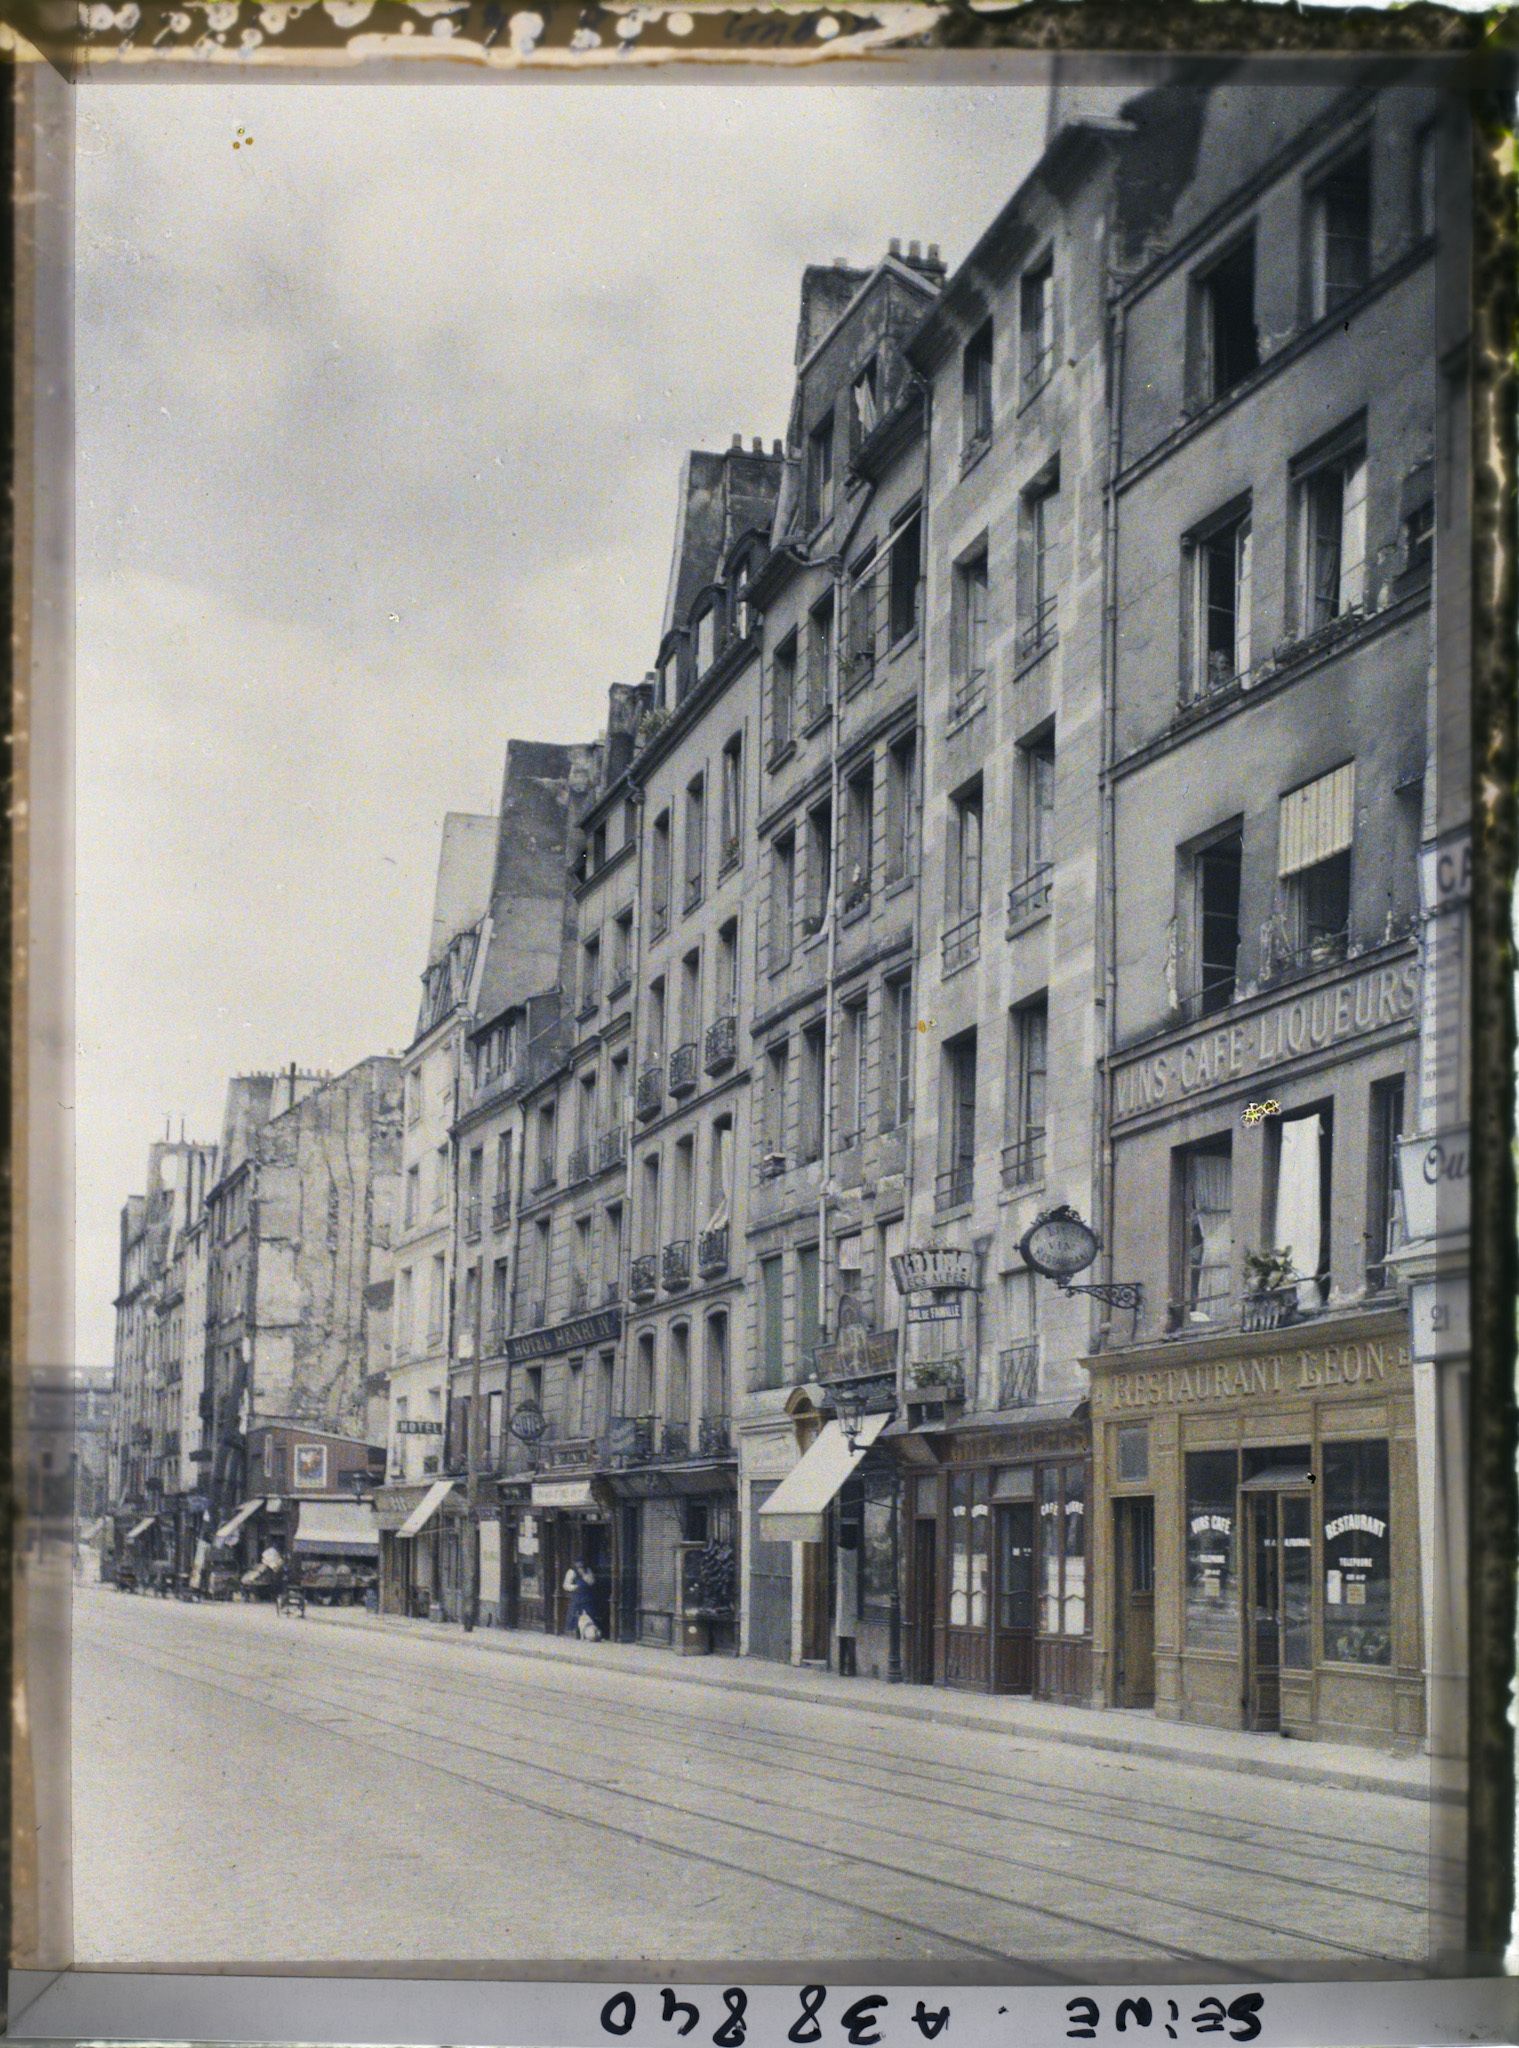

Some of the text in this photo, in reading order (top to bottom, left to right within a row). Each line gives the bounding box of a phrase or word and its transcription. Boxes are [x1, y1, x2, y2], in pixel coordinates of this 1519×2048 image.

[1117, 1057, 1167, 1112] VINS
[1258, 965, 1419, 1061] LIQUEURS
[513, 1334, 551, 1356] HOTEL
[555, 1319, 595, 1347] HENRI
[1110, 1354, 1284, 1409] RESTAURANT
[401, 1421, 440, 1434] HOTEL
[1325, 1514, 1386, 1540] RESTAURANT
